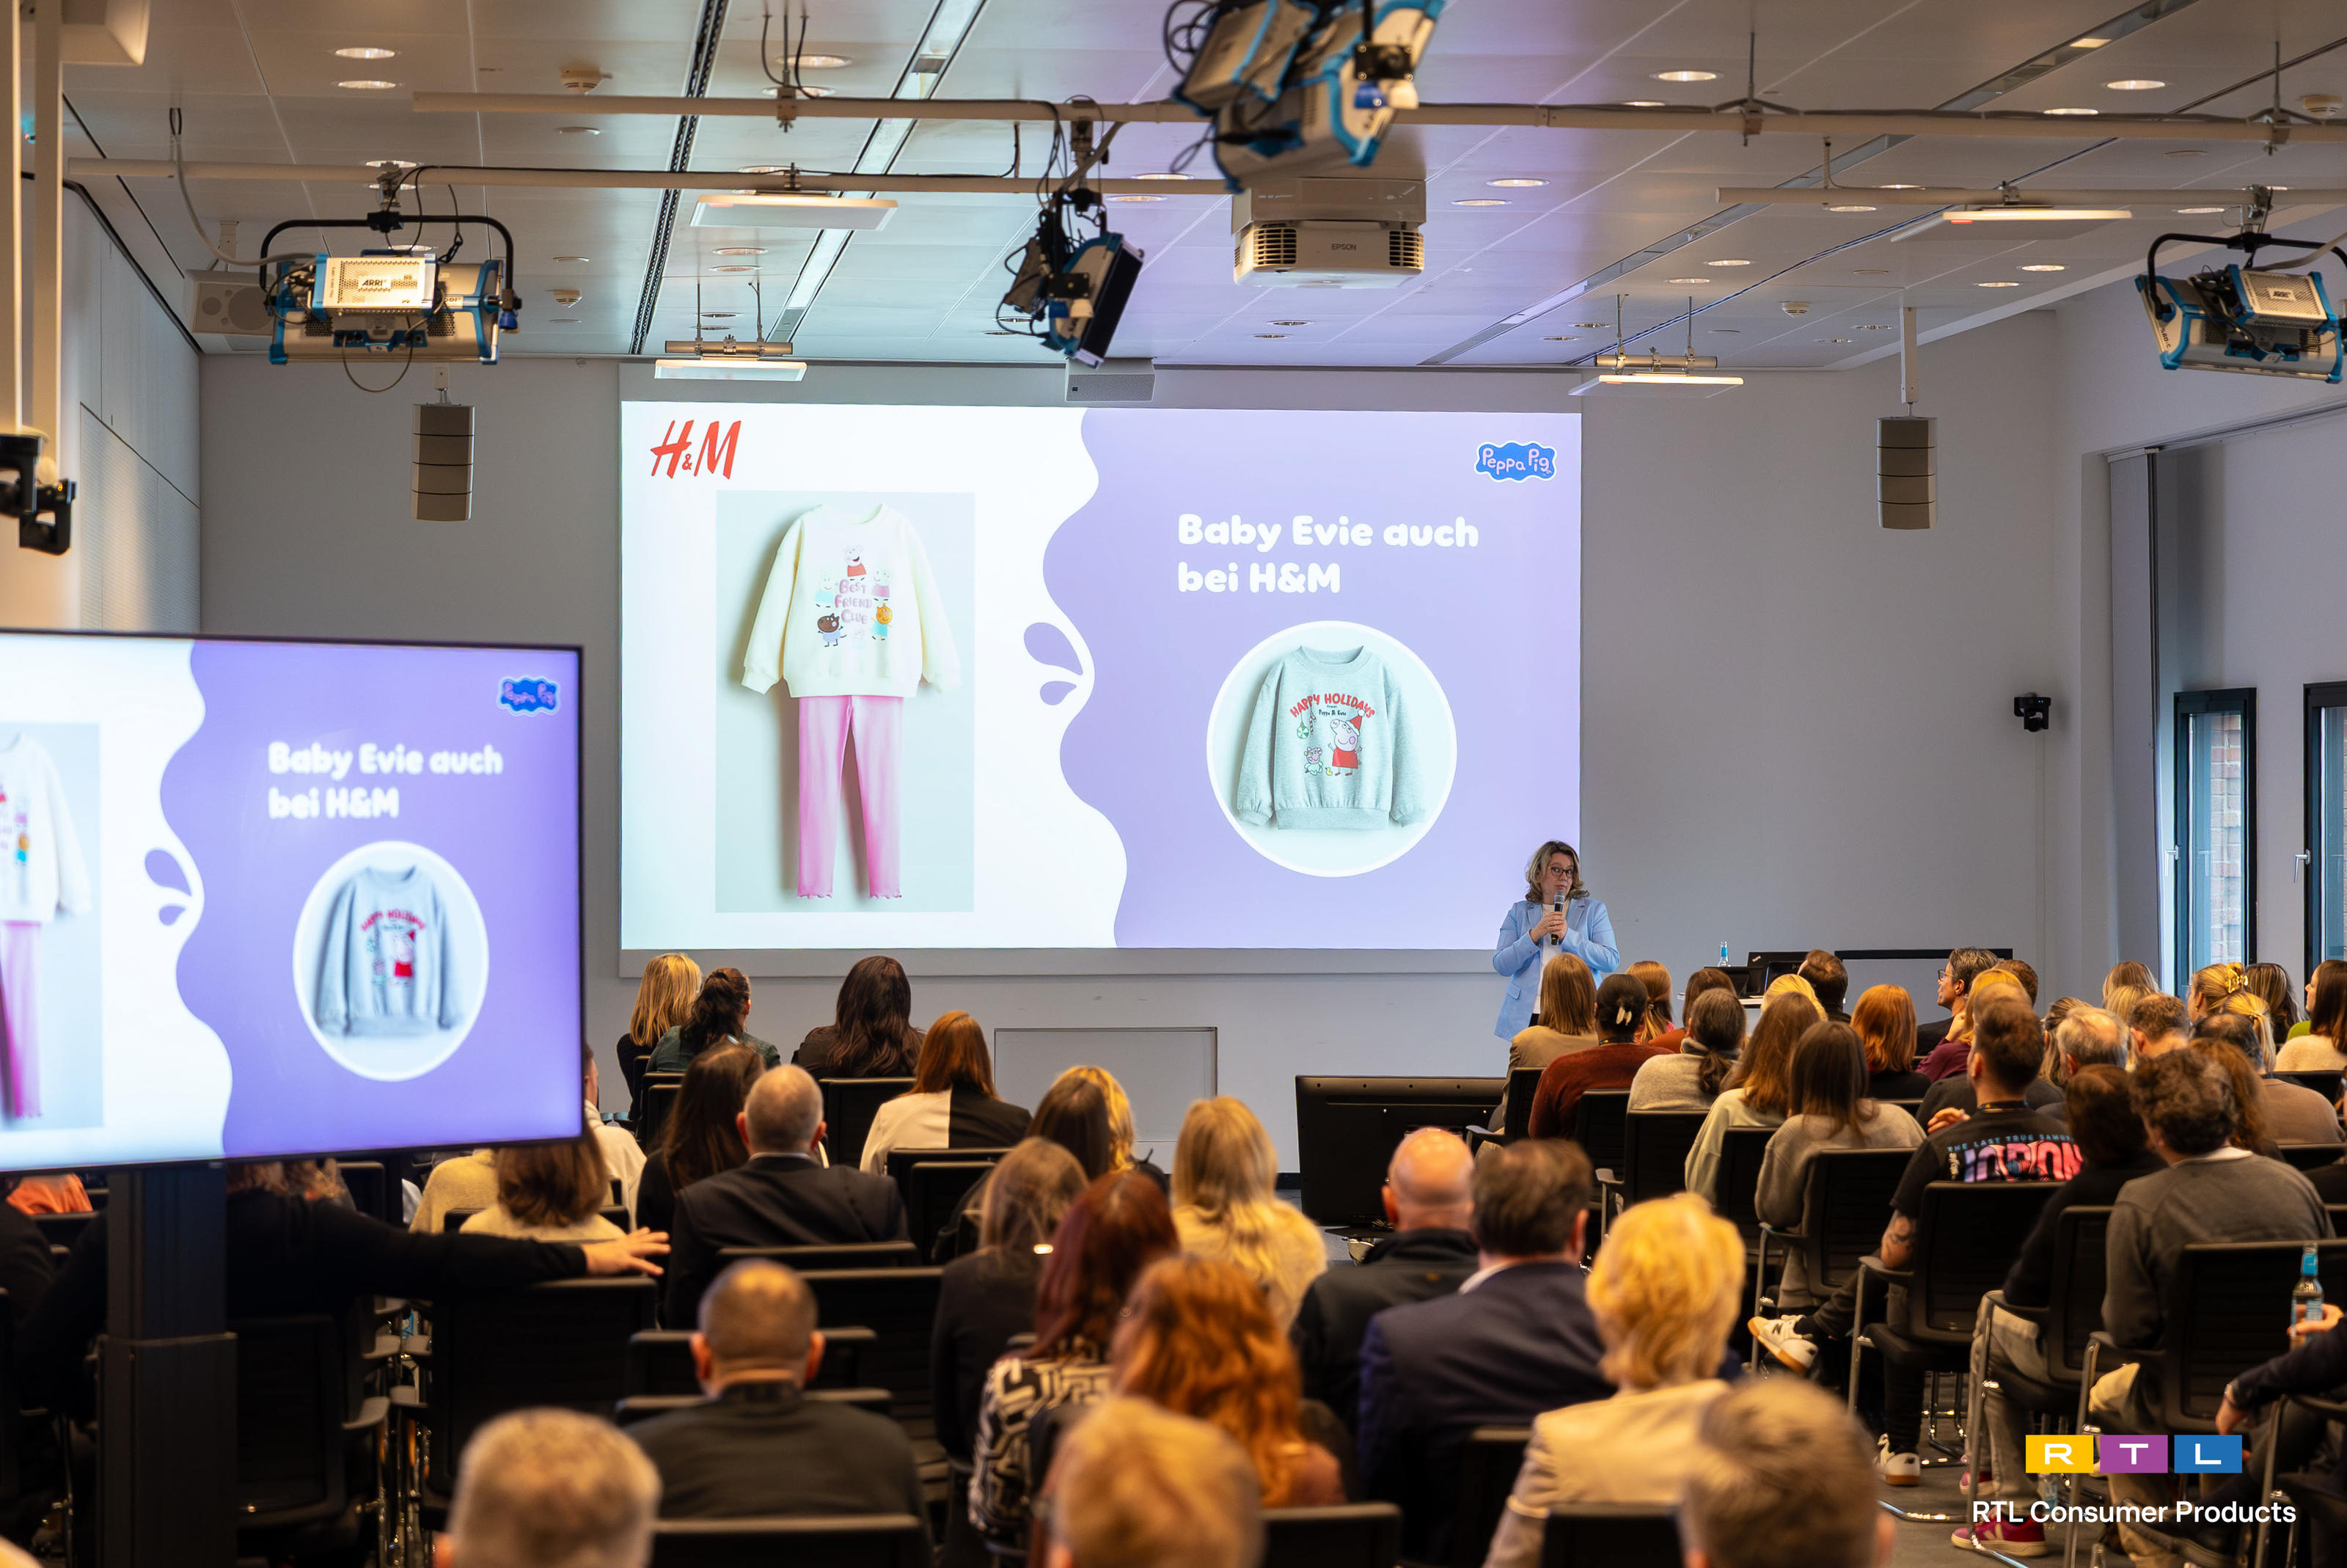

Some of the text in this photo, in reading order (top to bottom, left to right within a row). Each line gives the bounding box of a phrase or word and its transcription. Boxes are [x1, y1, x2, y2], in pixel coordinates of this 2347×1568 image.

[1331, 243, 1357, 251] EPSON
[362, 279, 384, 287] ARRI
[650, 419, 742, 480] H&M
[1482, 447, 1550, 476] Peppa Pig
[1178, 513, 1479, 553] Baby Evie auch
[1177, 560, 1341, 593] bei H&M
[1289, 692, 1375, 719] HAPPY HOLIDAYS
[268, 741, 503, 781] Baby Evie auch
[268, 786, 400, 820] bei H&M
